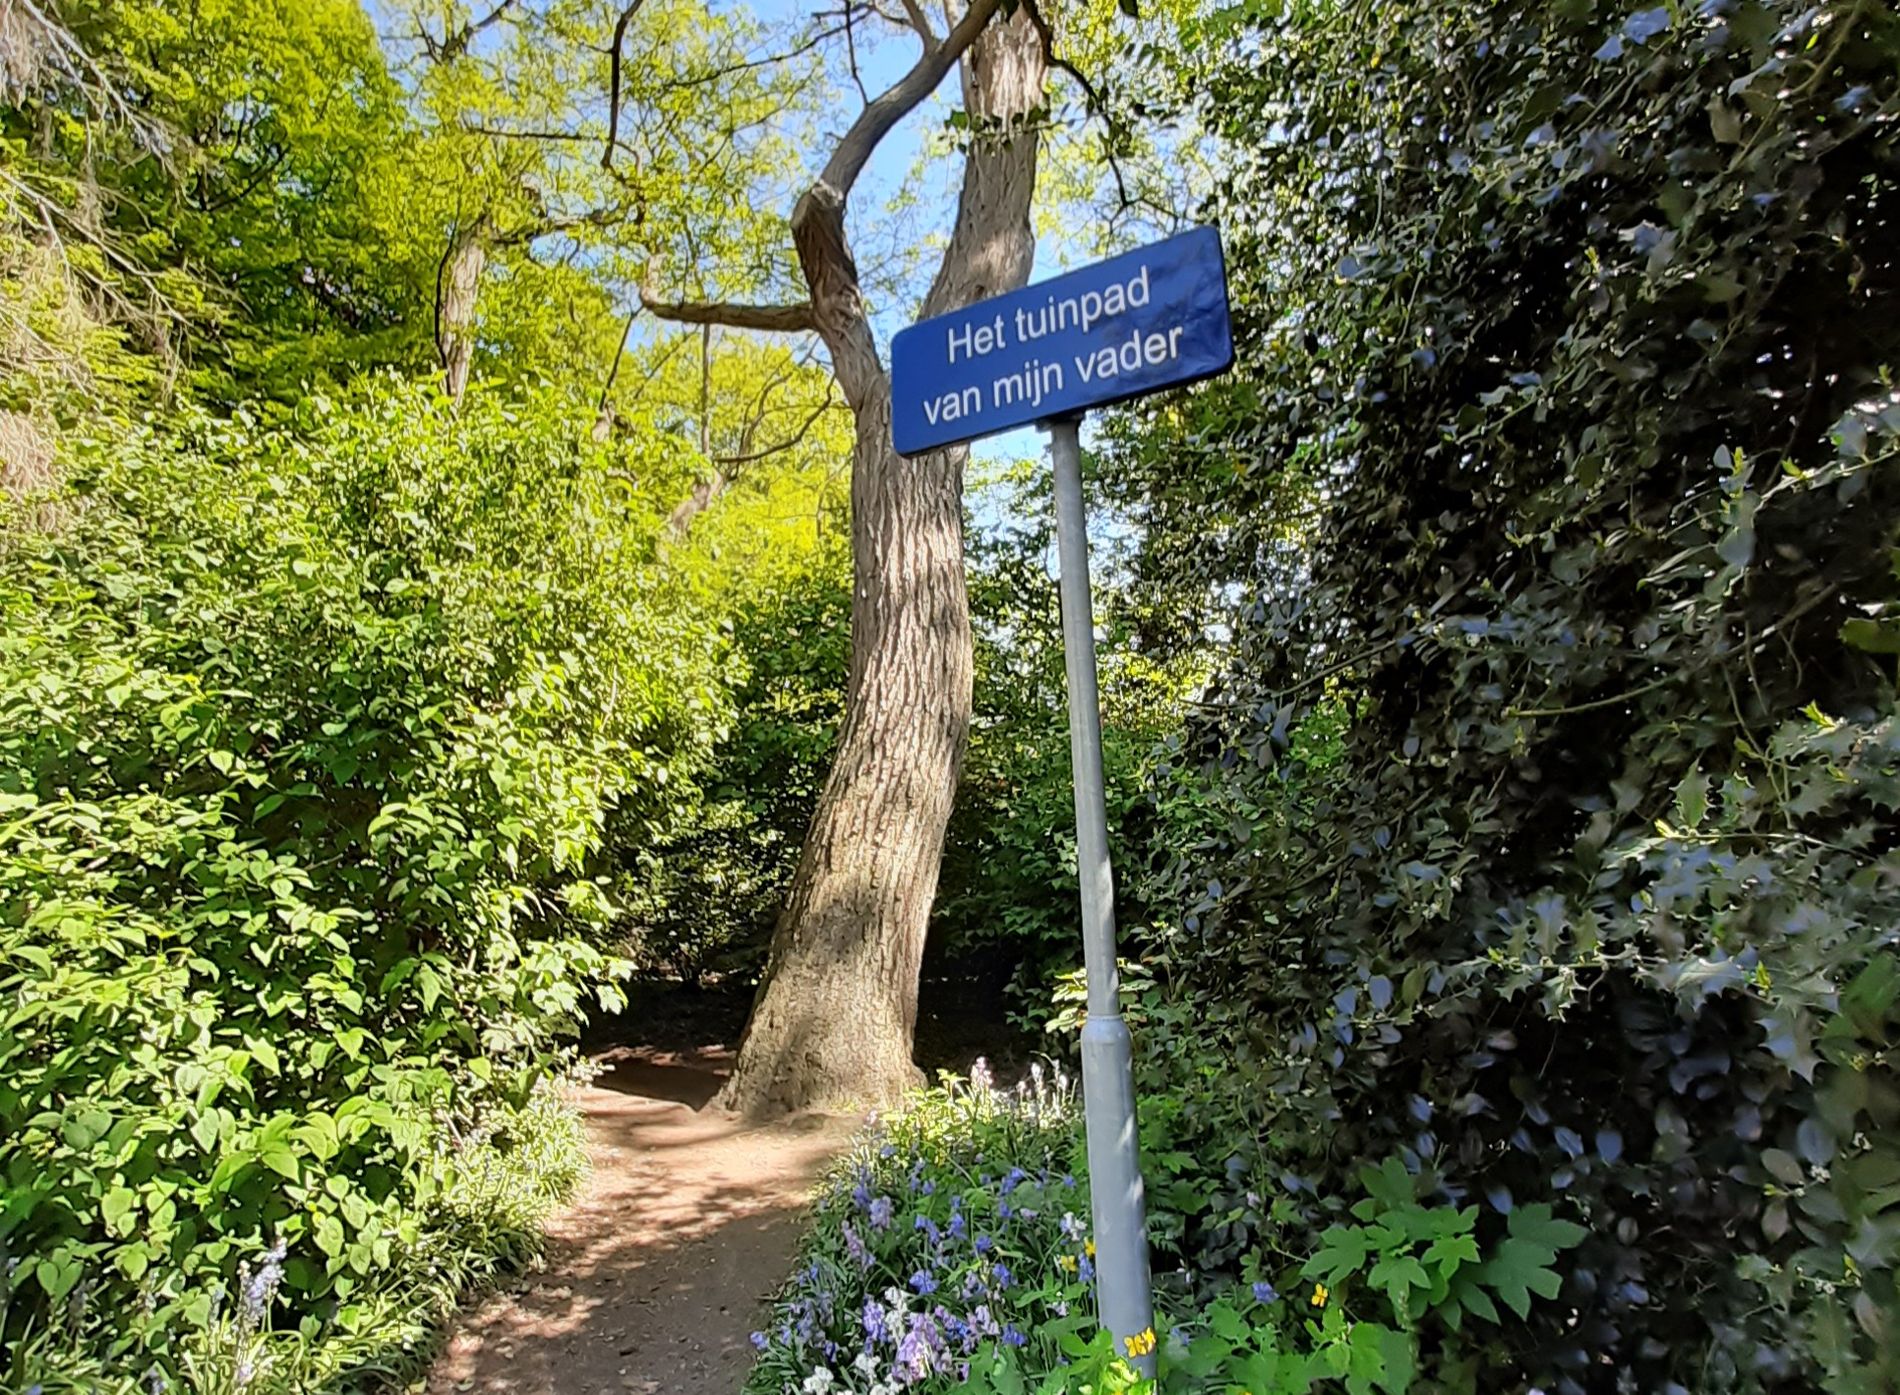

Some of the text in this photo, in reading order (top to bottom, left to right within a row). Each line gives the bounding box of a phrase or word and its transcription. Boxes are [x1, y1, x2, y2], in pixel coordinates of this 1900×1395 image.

[948, 265, 1150, 364] Het tuinpad
[923, 325, 1183, 426] van mijn vader
